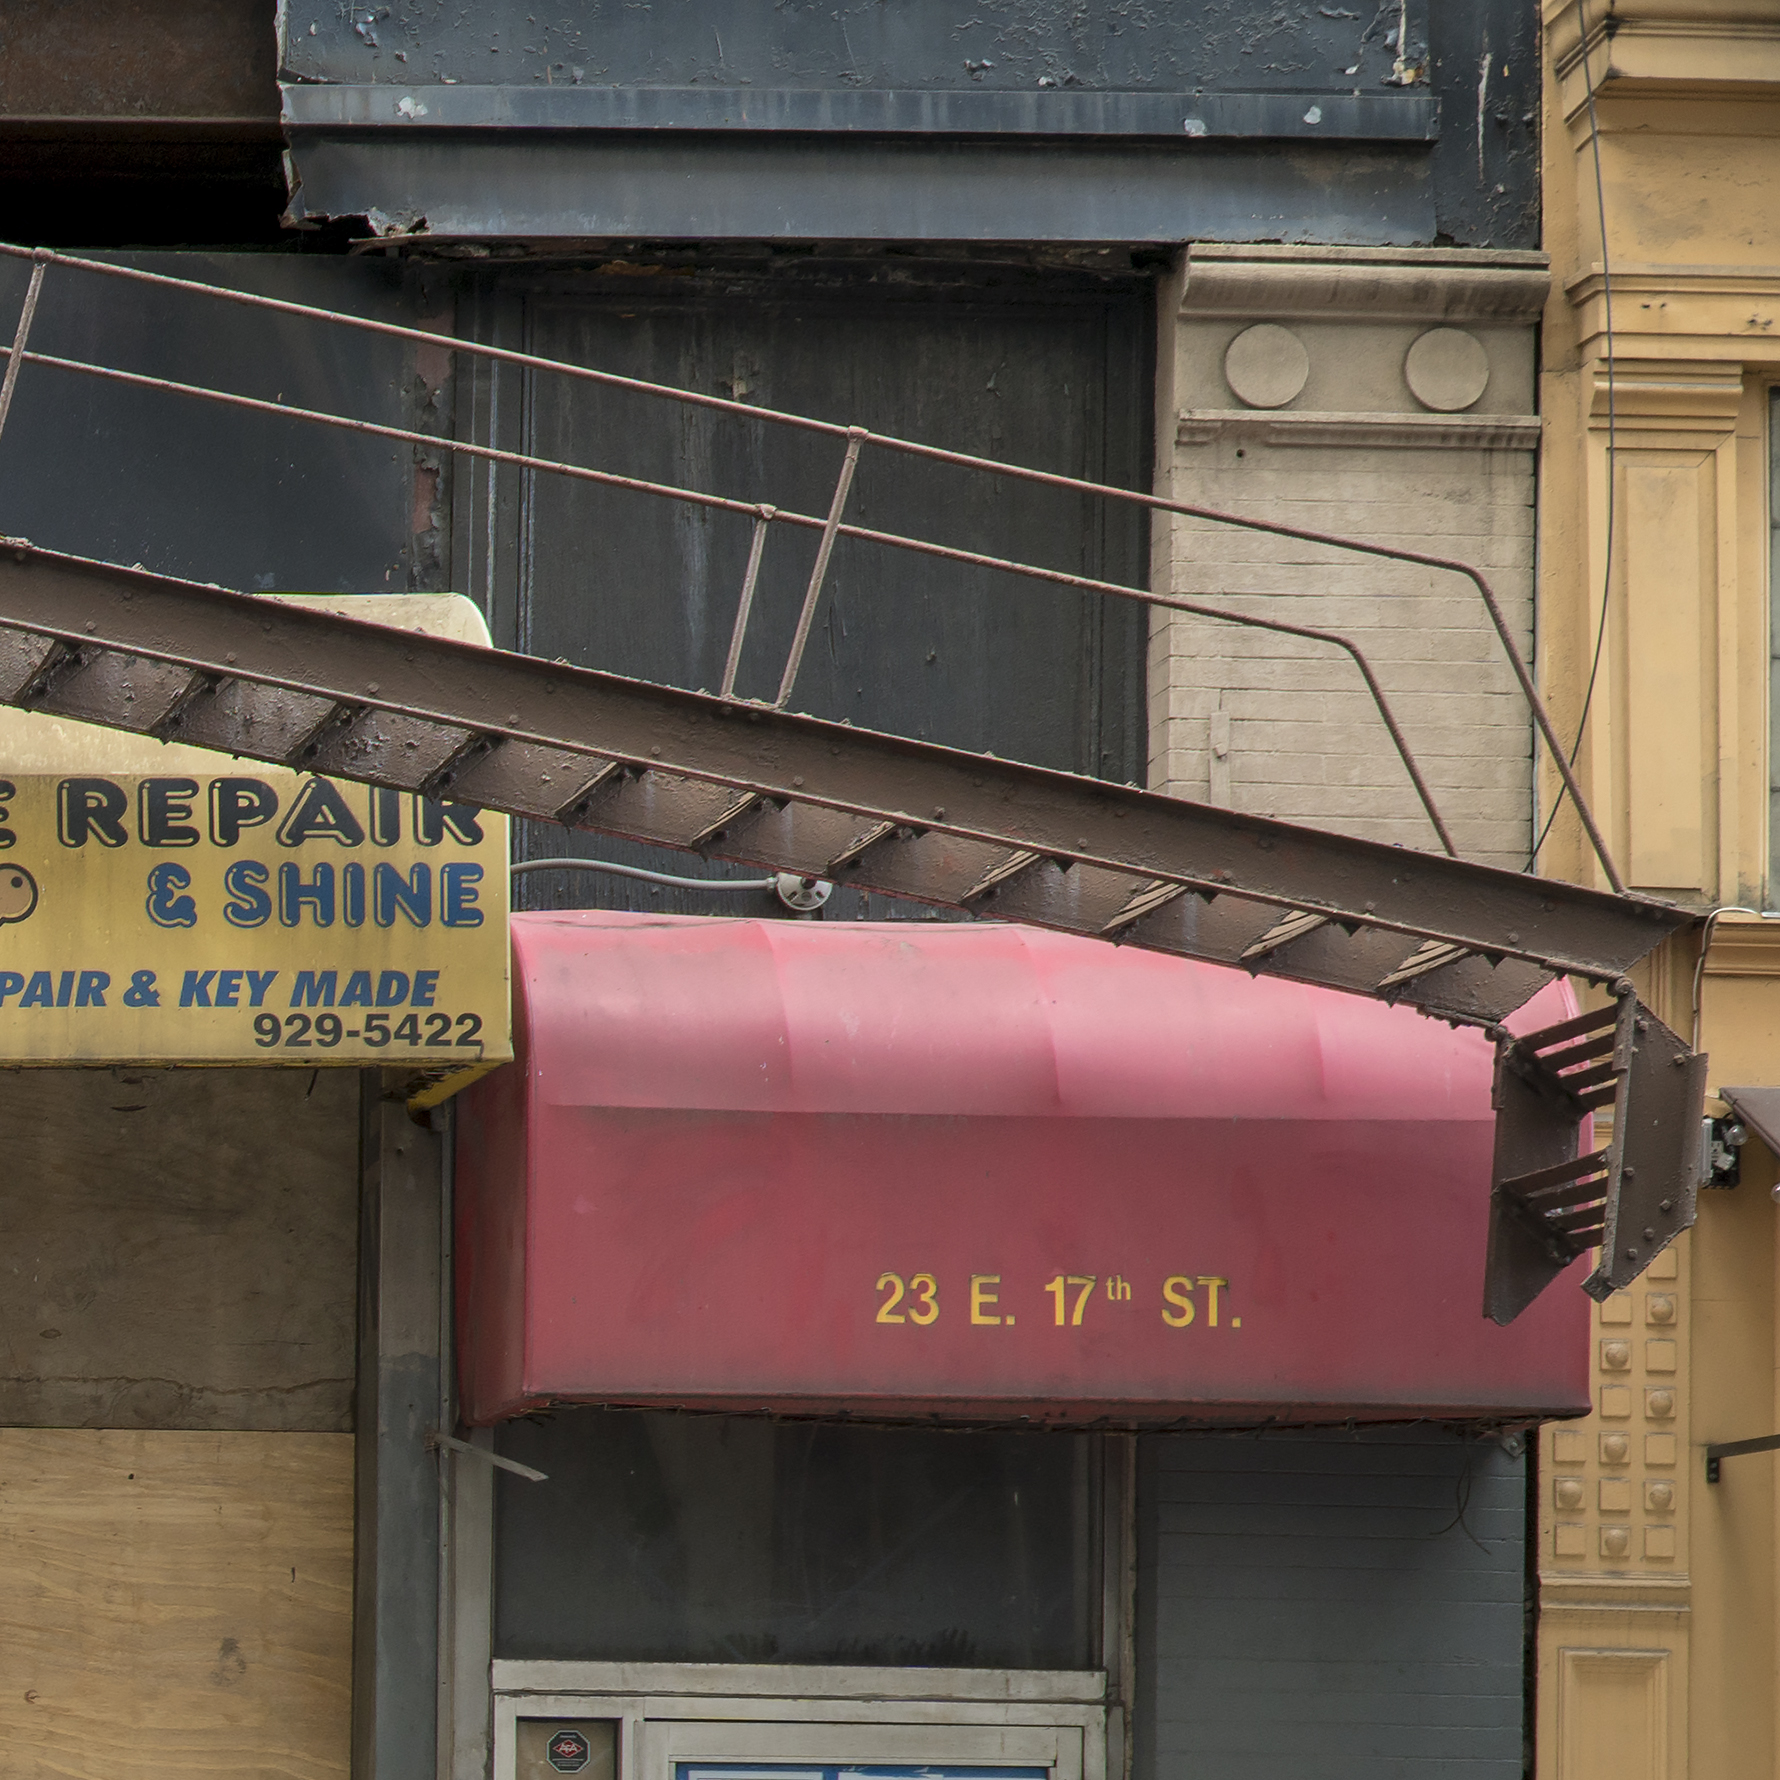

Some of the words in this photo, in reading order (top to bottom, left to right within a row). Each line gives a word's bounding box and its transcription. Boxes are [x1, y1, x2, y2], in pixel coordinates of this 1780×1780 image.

[56, 776, 485, 848] REPAIR
[146, 861, 198, 928] &
[223, 860, 485, 928] SHINE
[122, 969, 161, 1008] &
[179, 970, 279, 1008] KEY
[288, 970, 440, 1008] MADE
[253, 1012, 484, 1048] 929-5422
[876, 1271, 939, 1325] 23
[970, 1273, 1016, 1326] E.
[1044, 1273, 1132, 1327] 17th
[1162, 1275, 1241, 1328] ST.
